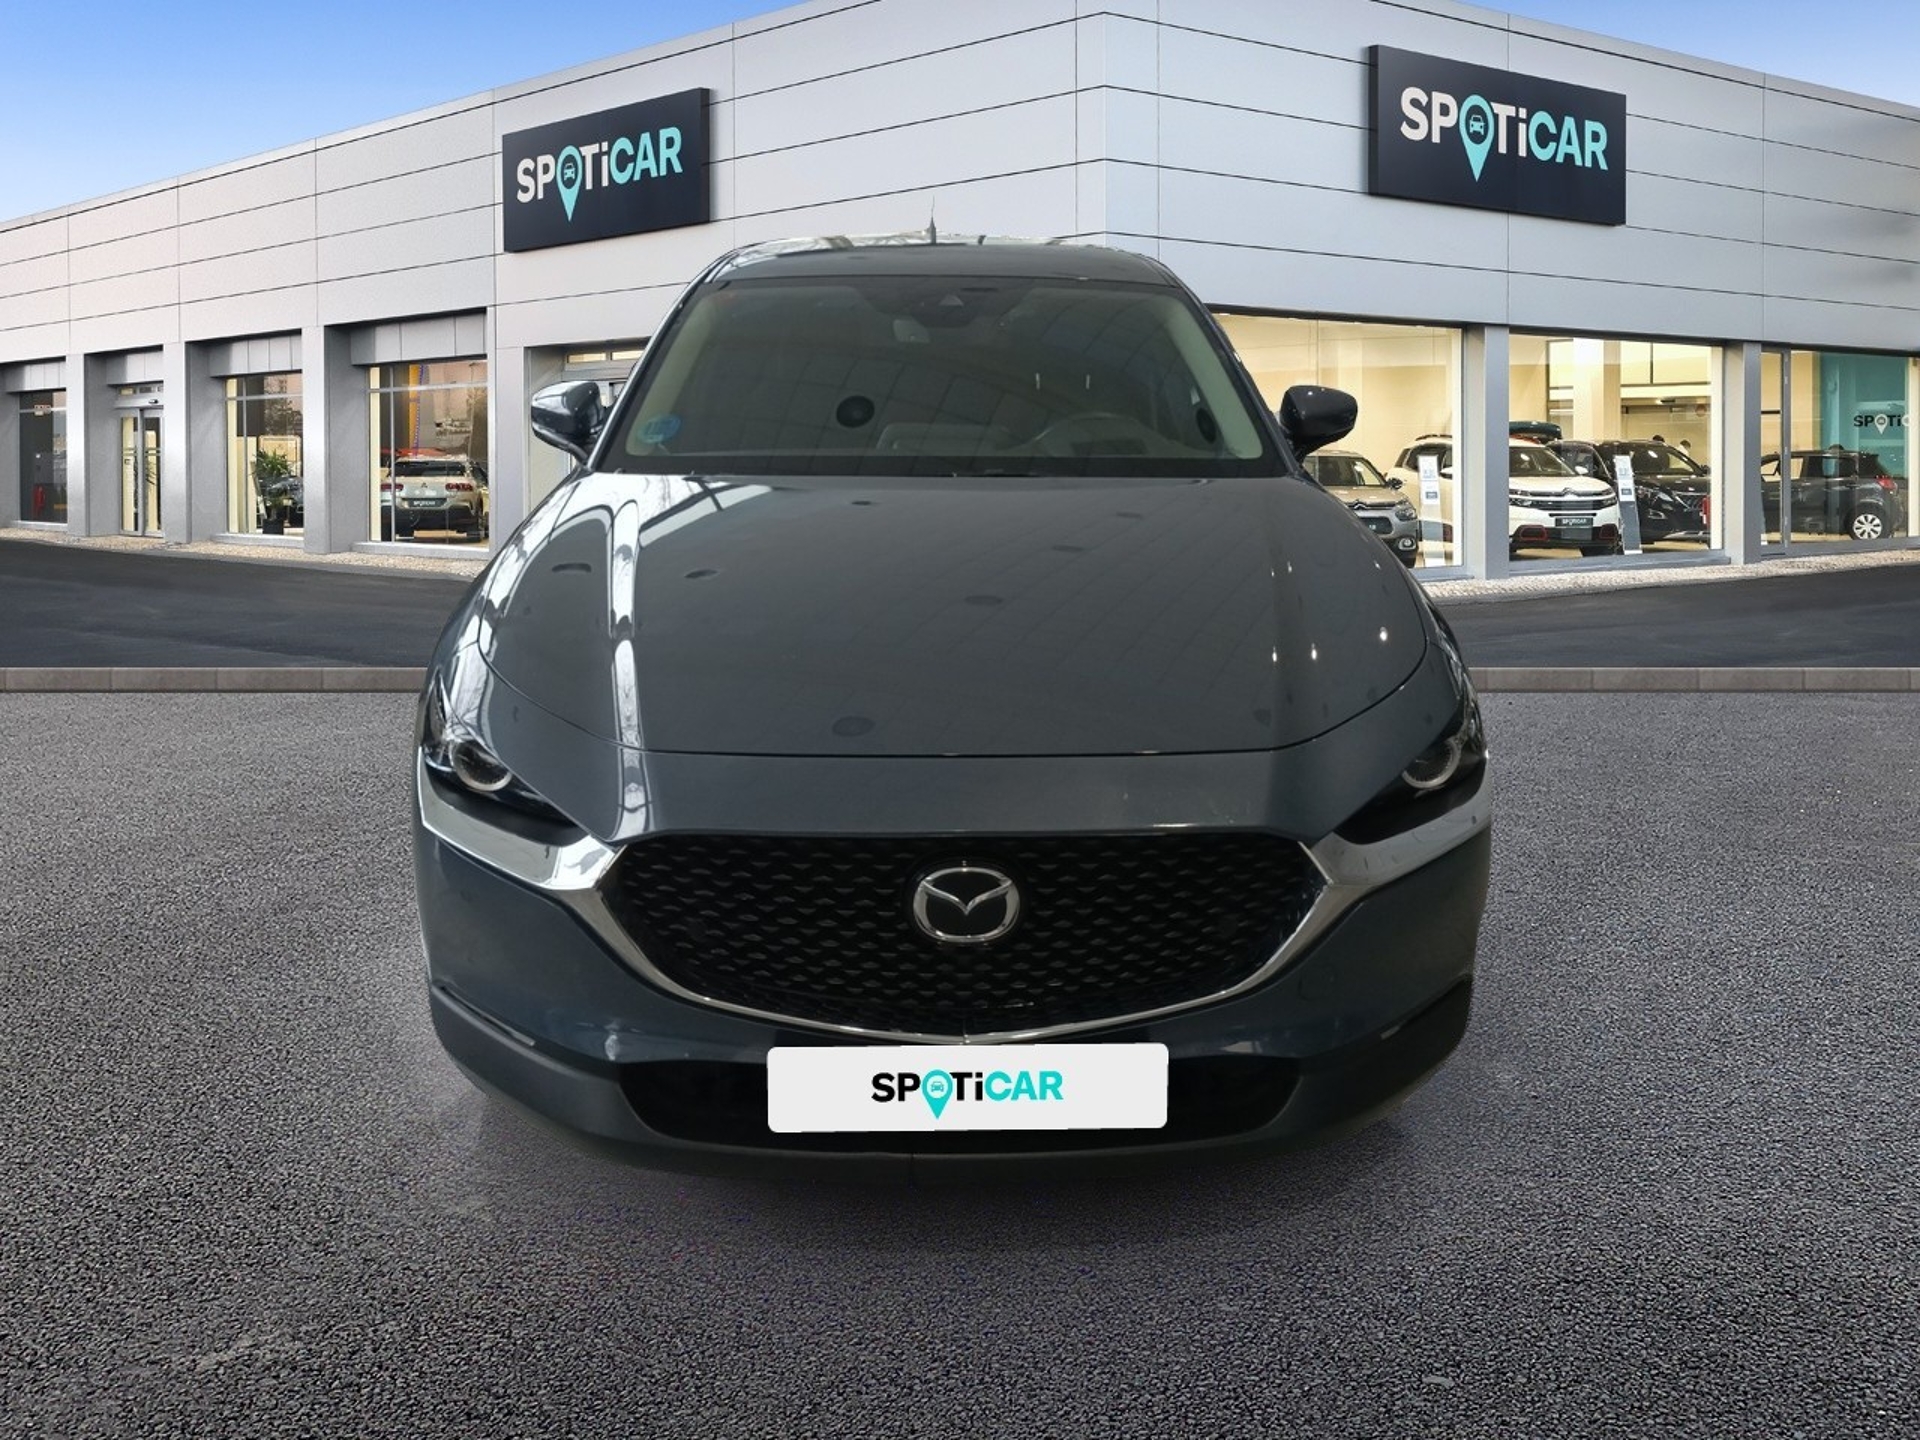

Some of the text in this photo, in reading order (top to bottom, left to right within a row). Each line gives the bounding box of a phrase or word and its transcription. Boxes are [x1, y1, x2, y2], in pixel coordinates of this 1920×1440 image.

[517, 127, 683, 222] SPOTiCAR
[1400, 86, 1608, 182] SPOTiCAR
[871, 1069, 1064, 1119] SPOTiCAR
